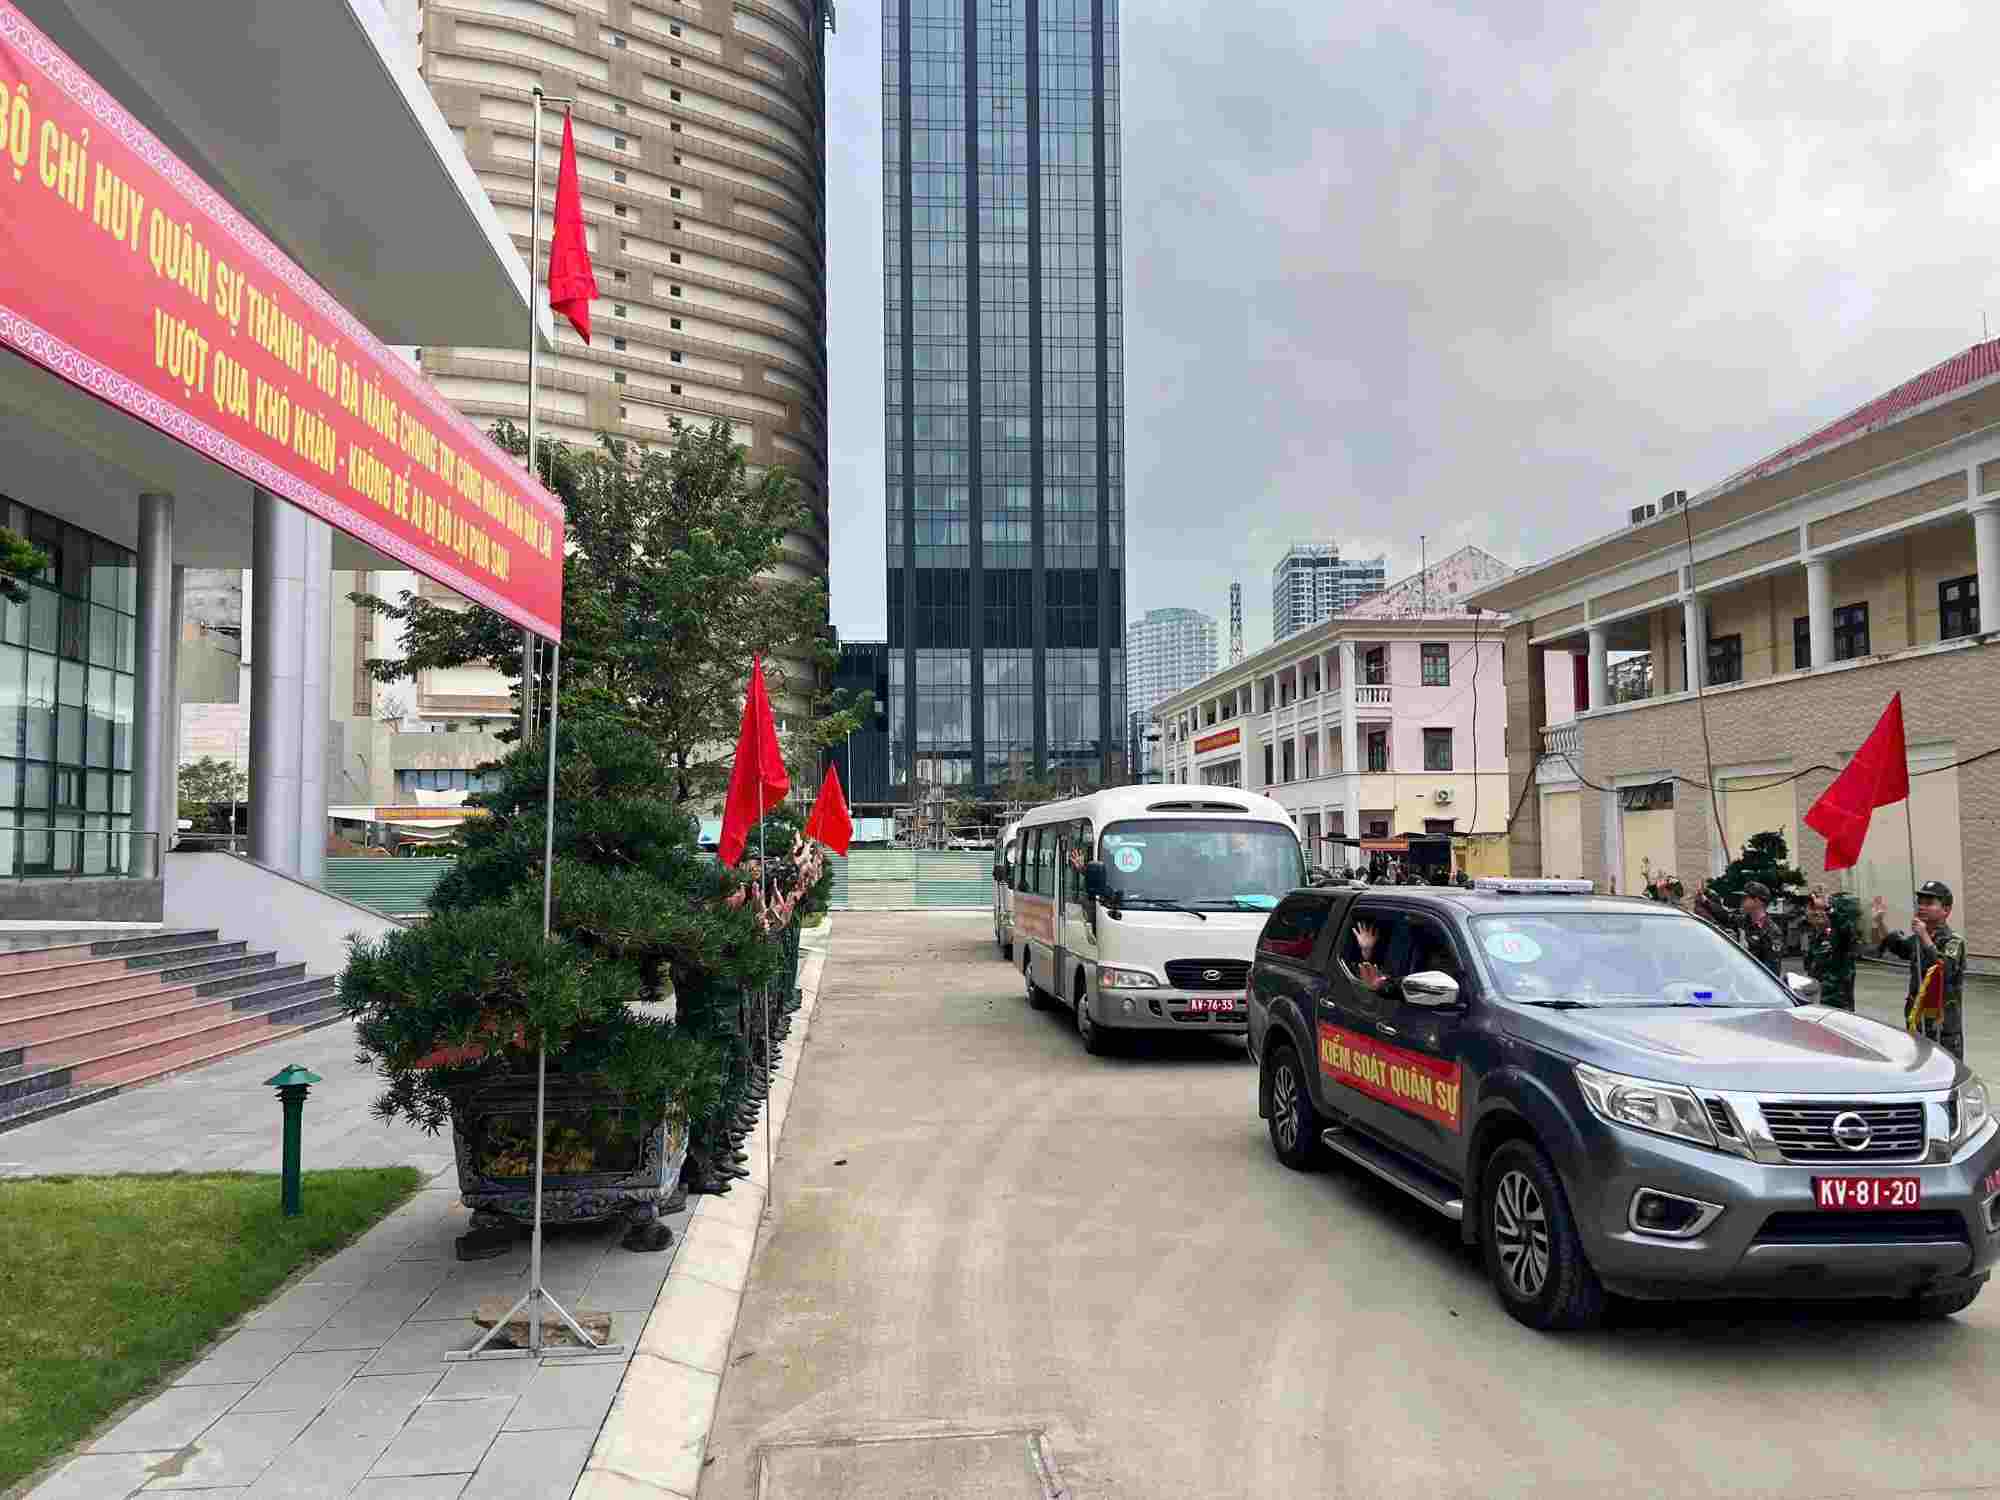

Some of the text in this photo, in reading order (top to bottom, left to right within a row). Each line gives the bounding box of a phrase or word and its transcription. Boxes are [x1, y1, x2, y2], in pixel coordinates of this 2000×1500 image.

[40, 119, 90, 213] CHỈ
[93, 159, 145, 252] HUY
[149, 207, 211, 304] QUÂN
[215, 260, 245, 337] SỰ
[247, 284, 304, 375] THÀNH
[307, 333, 340, 398] PHỐ
[340, 359, 359, 417] ĐÀ
[362, 370, 398, 445] NẴNG
[400, 410, 439, 473] CHUNG
[439, 440, 457, 488] TAY
[154, 306, 209, 398] VƯỢT
[212, 350, 249, 423] QUA
[255, 376, 290, 446] KHÓ
[293, 404, 337, 475] KHĂN
[347, 441, 393, 513] KHÔNG
[394, 465, 411, 521] ĐỂ
[410, 486, 424, 529] AI
[1321, 1034, 1460, 1121] KIỂM SOÁT QUÂN SỰ
[1821, 1179, 1917, 1205] KV-81-20
